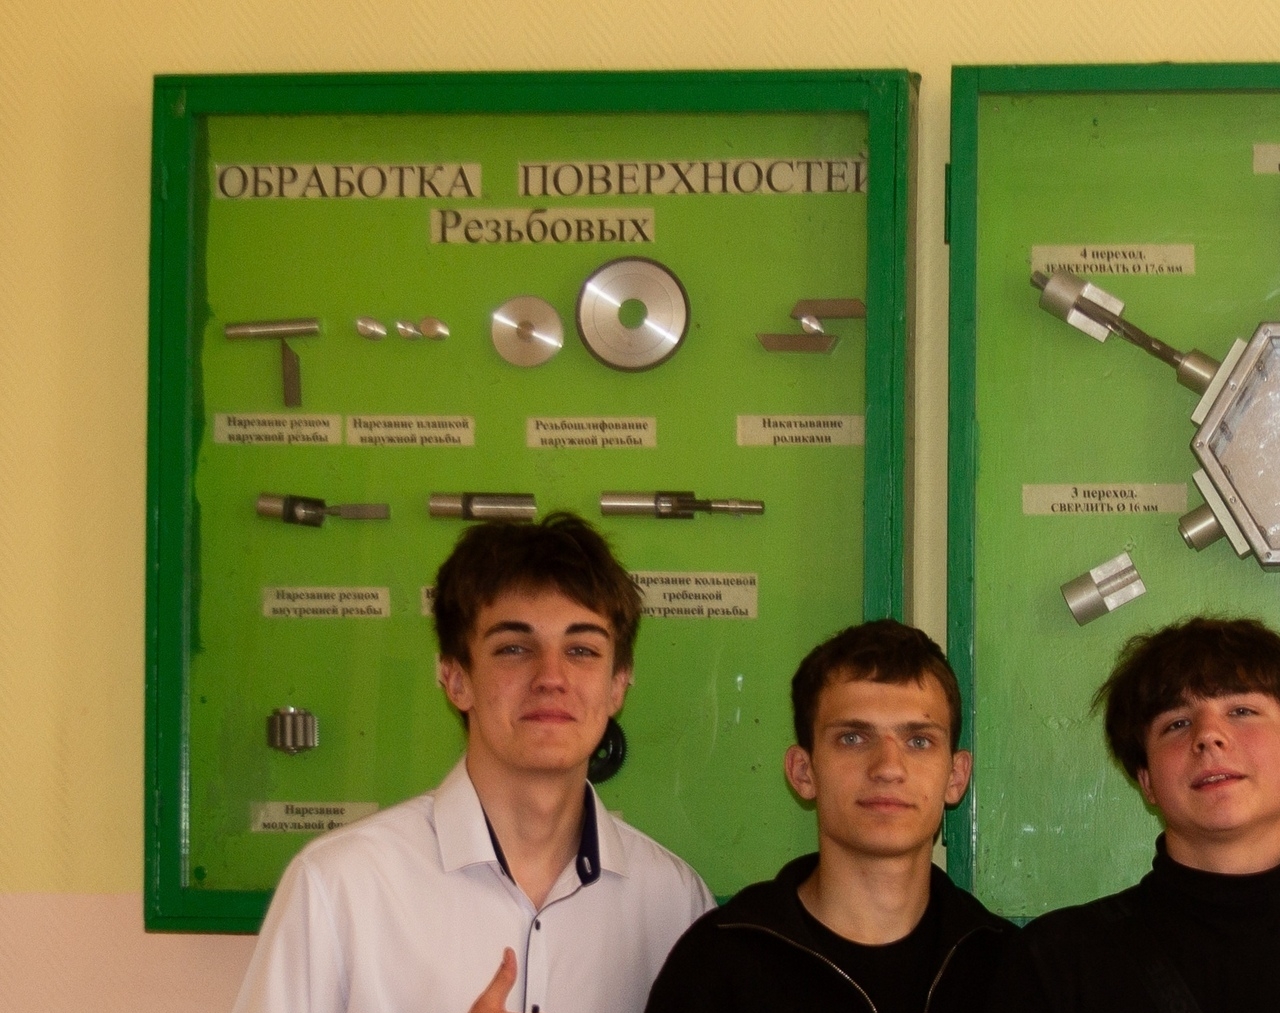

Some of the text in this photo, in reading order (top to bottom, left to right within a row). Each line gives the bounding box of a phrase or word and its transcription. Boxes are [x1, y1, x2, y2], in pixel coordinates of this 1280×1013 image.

[218, 164, 476, 199] ОБРАБОТКА
[436, 208, 652, 244] Резьбовых
[1080, 248, 1088, 260] 4
[352, 417, 414, 431] Нарезание
[762, 417, 844, 429] Накатывание
[1070, 486, 1079, 499] 3
[1051, 502, 1114, 513] СВЕРЛИТЬ
[694, 574, 757, 586] кольцевой
[708, 605, 749, 618] резьбы
[284, 803, 346, 817] Нарезание
